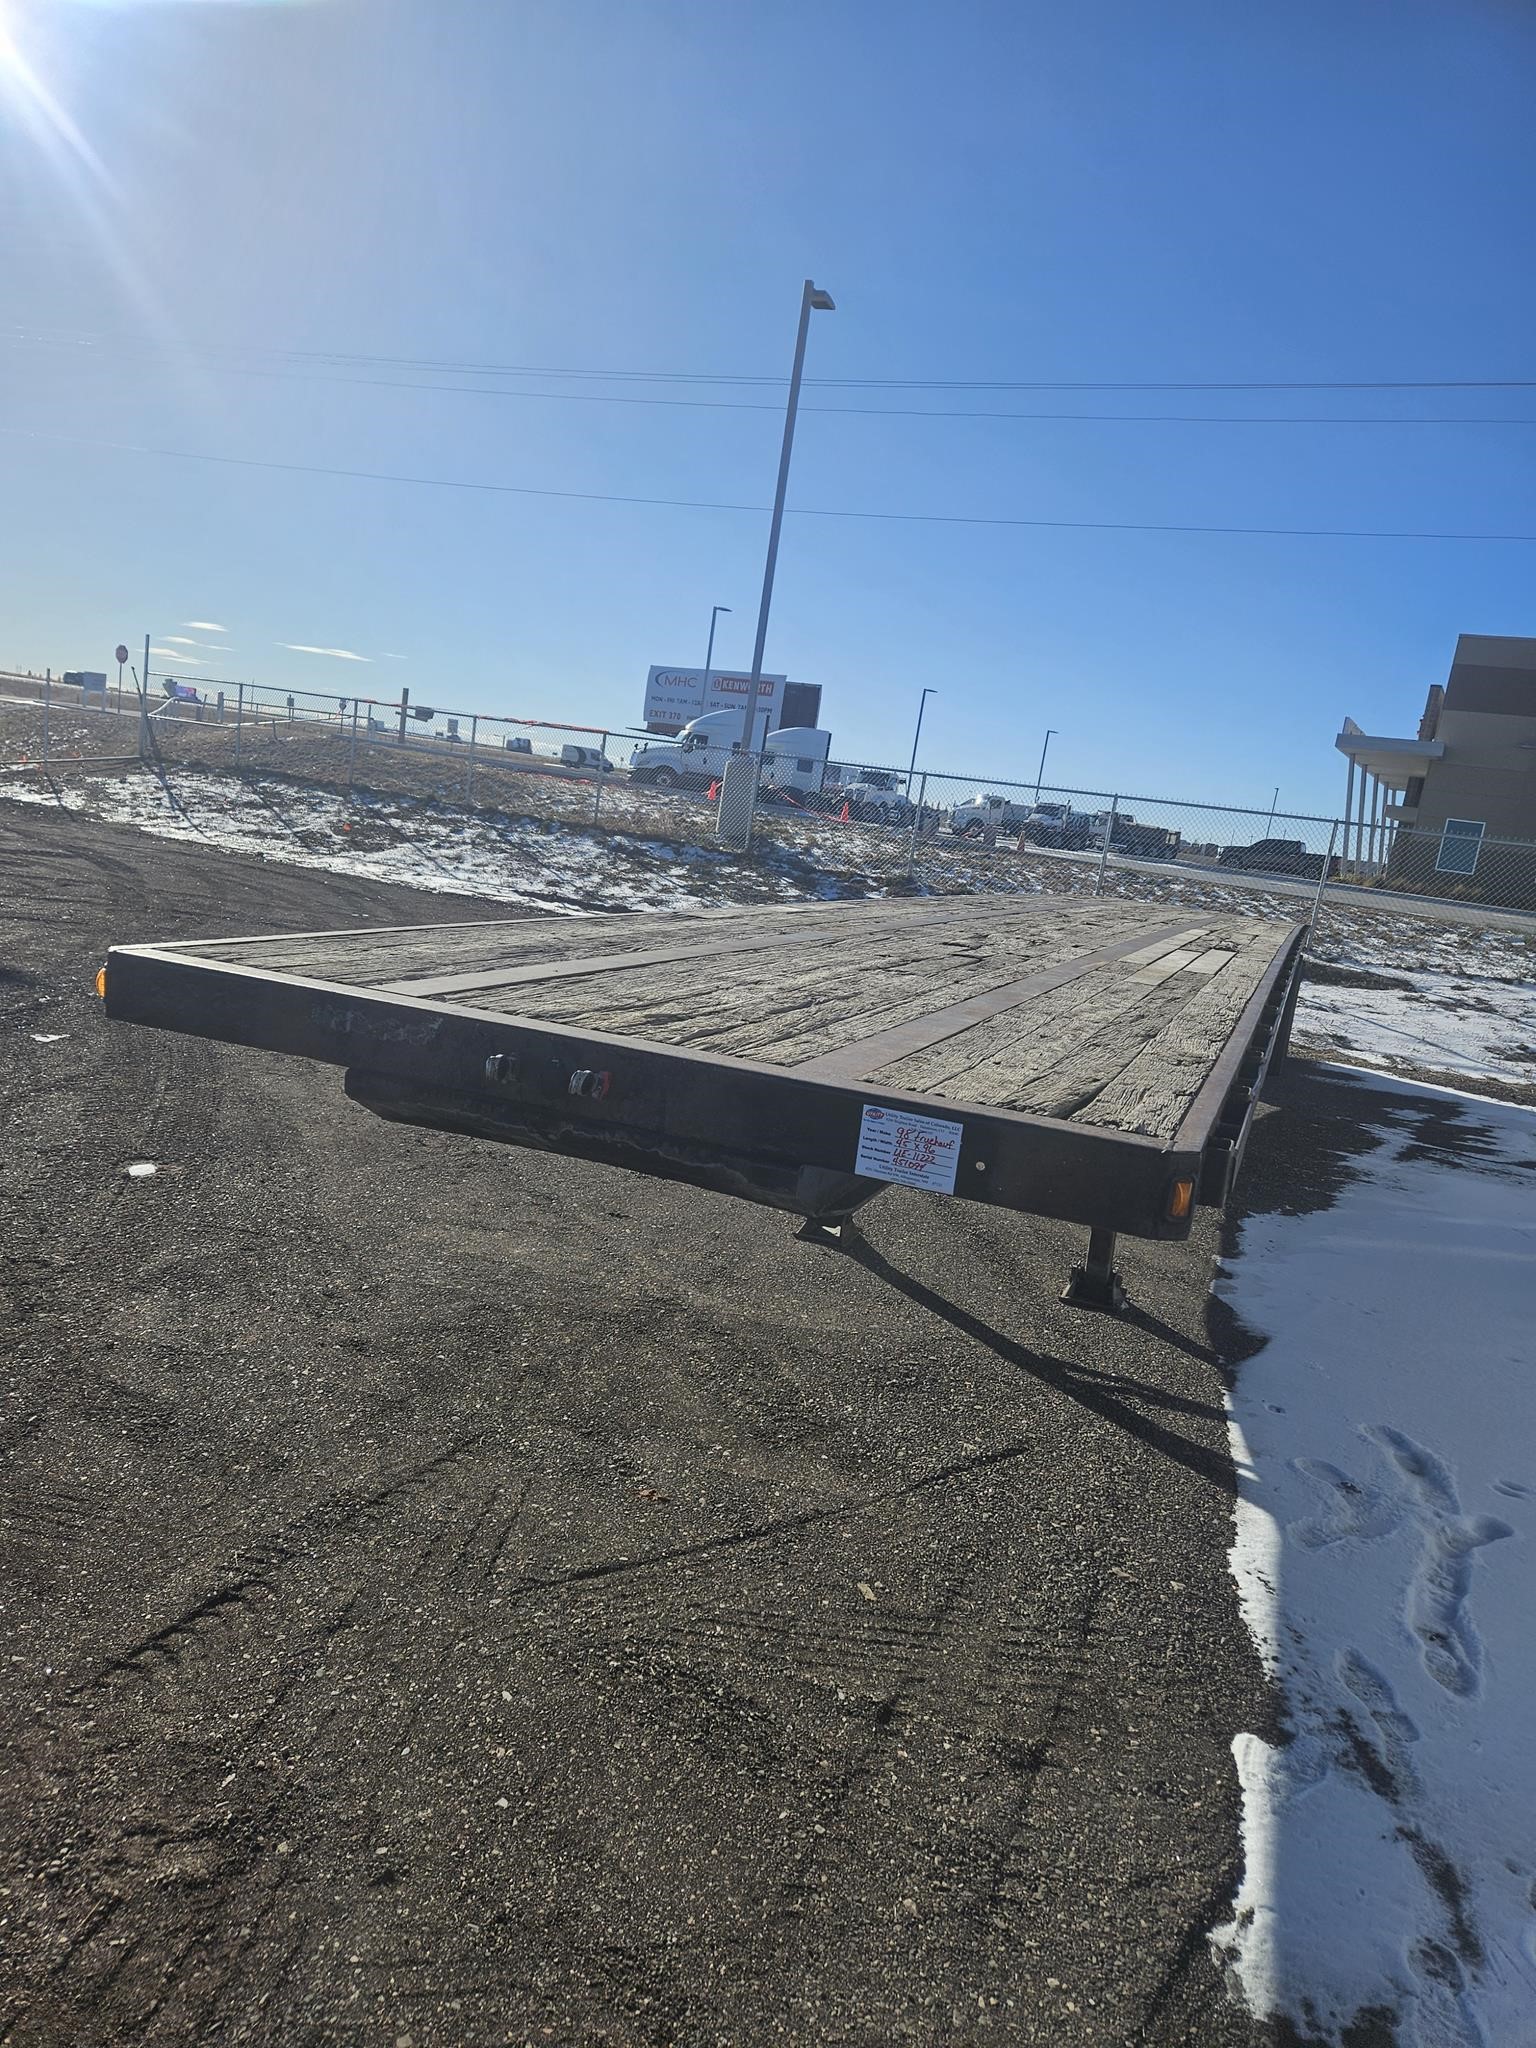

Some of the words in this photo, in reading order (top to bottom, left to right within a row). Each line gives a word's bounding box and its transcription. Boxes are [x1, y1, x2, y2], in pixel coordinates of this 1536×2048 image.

[664, 674, 698, 688] MHC
[649, 709, 666, 718] EXIT
[669, 712, 681, 720] 370
